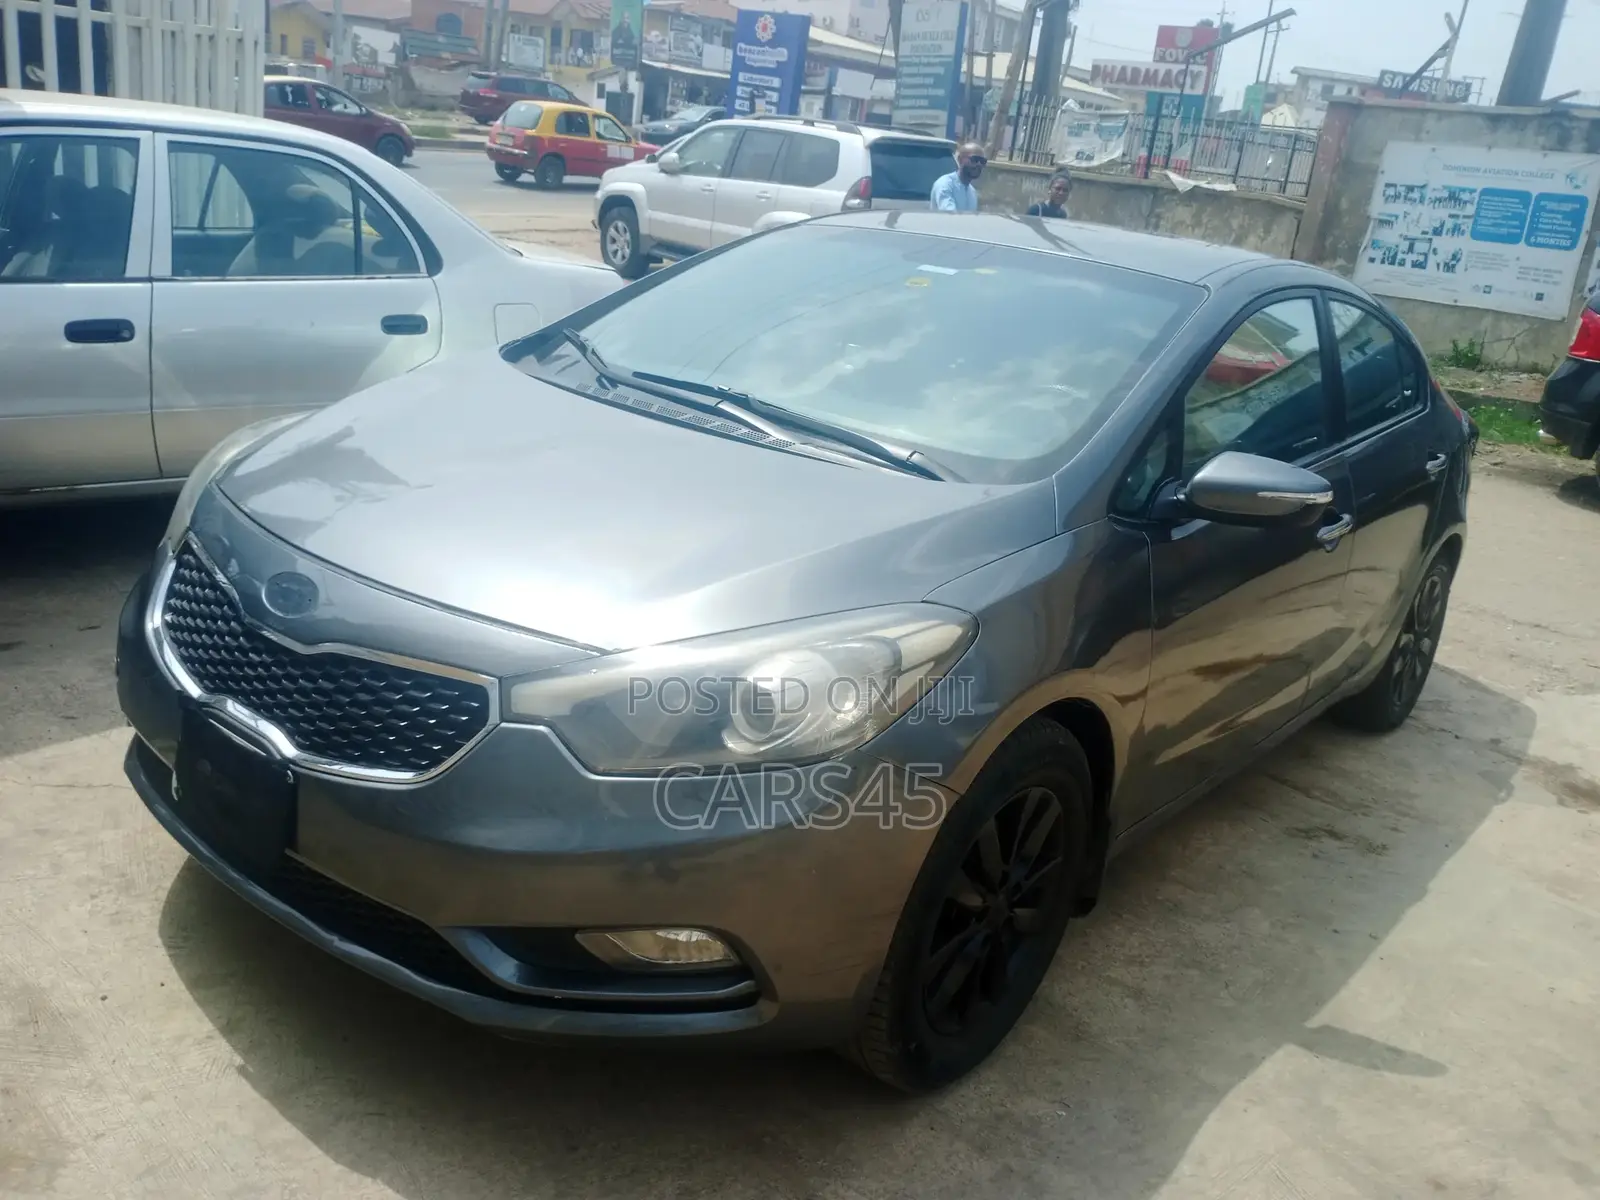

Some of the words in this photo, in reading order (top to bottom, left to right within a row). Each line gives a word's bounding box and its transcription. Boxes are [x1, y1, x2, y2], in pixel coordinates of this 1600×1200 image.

[1090, 64, 1204, 90] PHARMACY
[1442, 163, 1481, 173] DOMINION
[1482, 167, 1519, 177] AVIATION
[1521, 169, 1556, 180] COLLEGE
